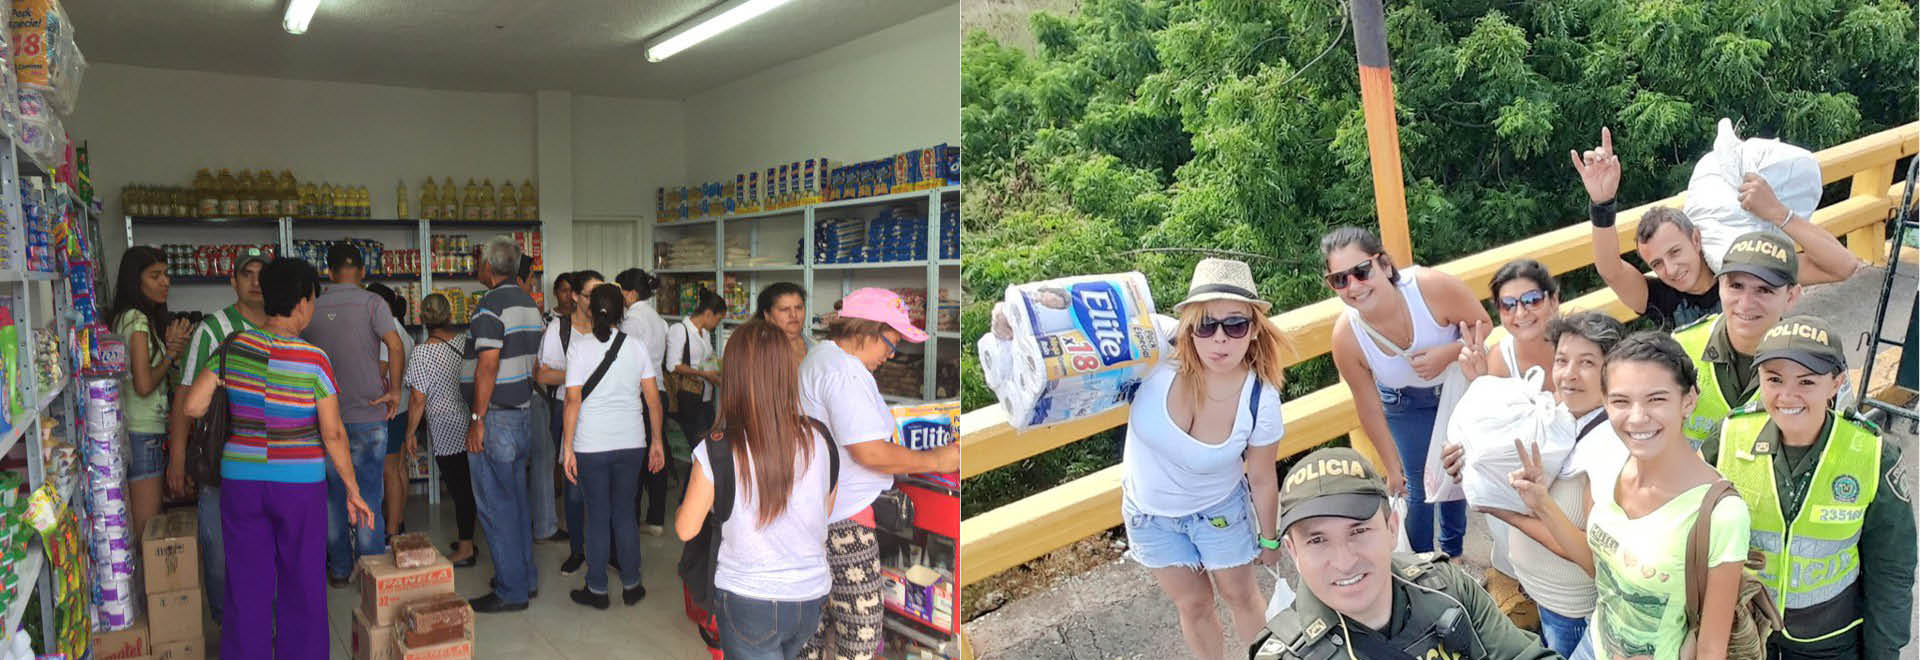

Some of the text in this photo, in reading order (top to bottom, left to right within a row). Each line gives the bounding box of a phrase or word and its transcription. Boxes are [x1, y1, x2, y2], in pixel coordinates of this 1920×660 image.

[1729, 239, 1788, 264] POLICIA
[1080, 289, 1125, 360] Elite
[1763, 322, 1829, 346] POLICIA
[910, 425, 950, 451] Elite
[1285, 458, 1366, 494] POLICIA
